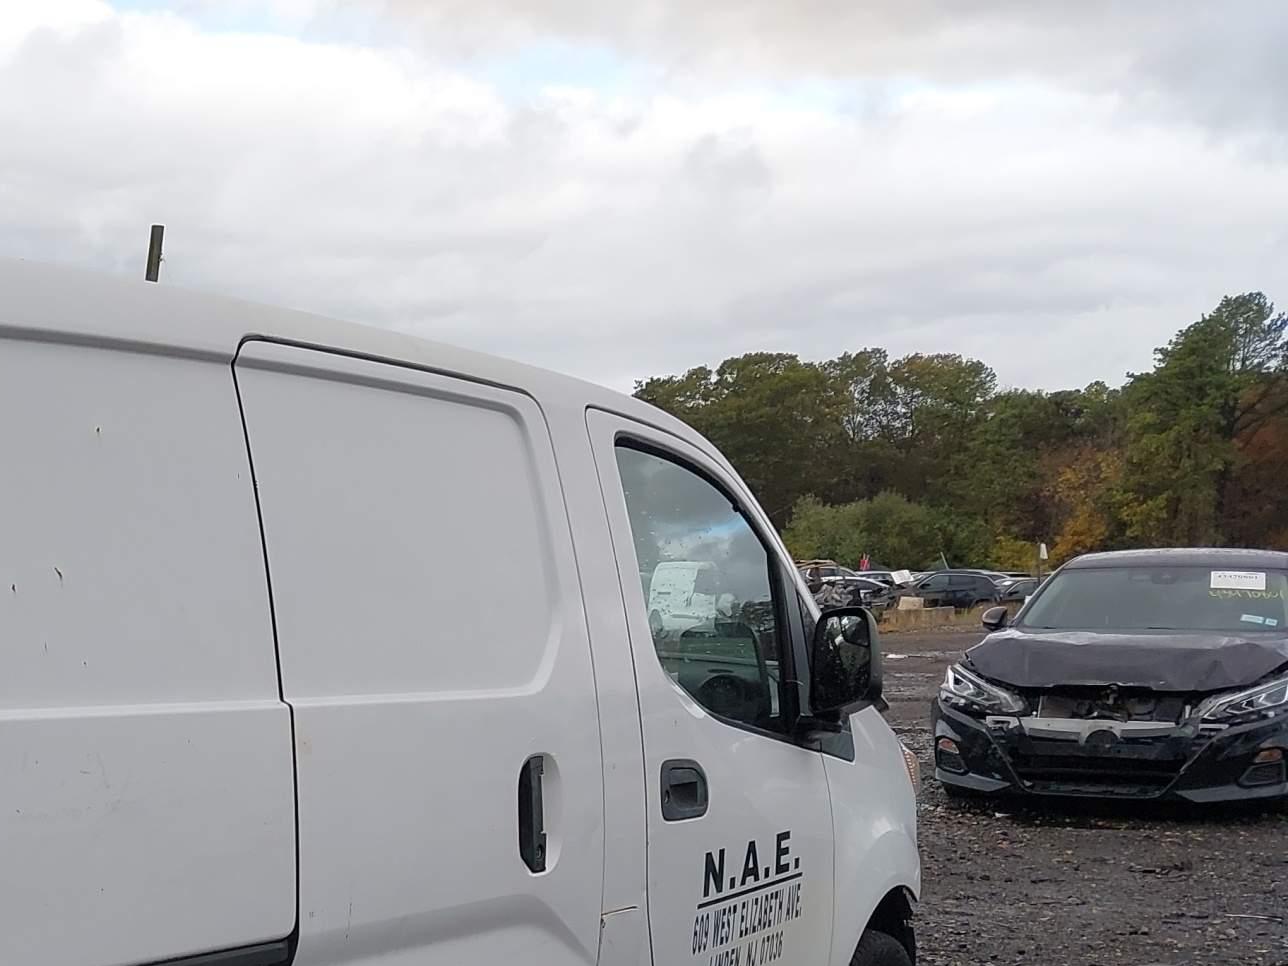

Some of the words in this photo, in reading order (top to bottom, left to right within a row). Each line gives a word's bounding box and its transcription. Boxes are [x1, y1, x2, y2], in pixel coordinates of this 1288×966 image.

[703, 830, 800, 897] N.A.E.
[692, 913, 710, 955] 609
[712, 904, 738, 949] WEST
[739, 889, 784, 938] ELIZABETH
[785, 883, 802, 921] AVE.
[759, 930, 784, 966] 07036
